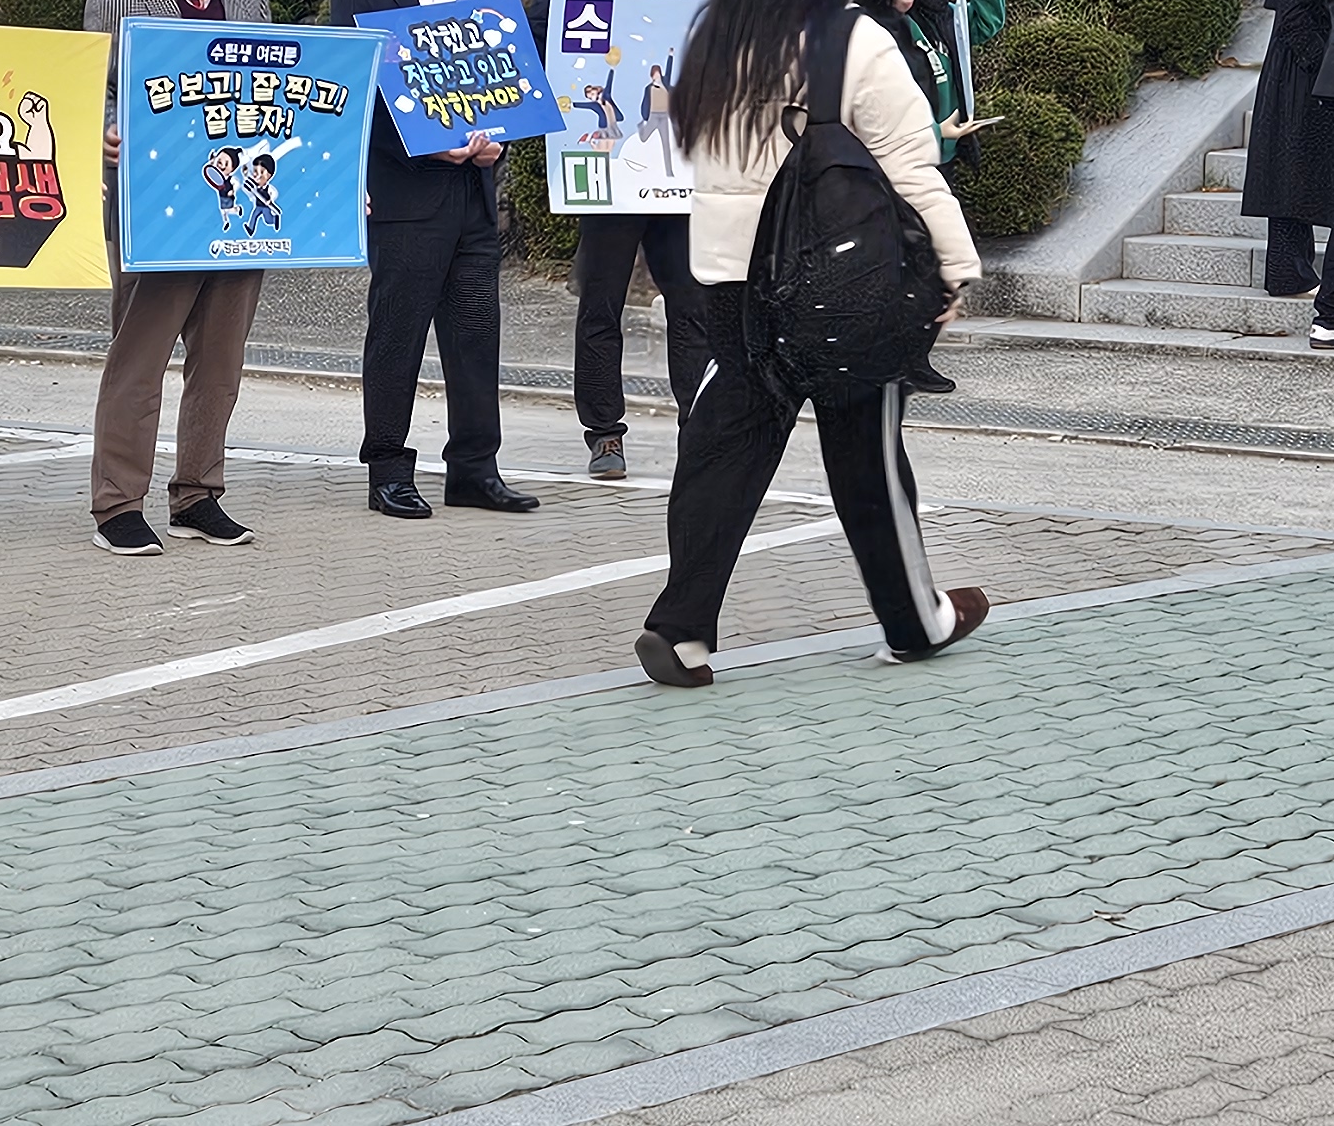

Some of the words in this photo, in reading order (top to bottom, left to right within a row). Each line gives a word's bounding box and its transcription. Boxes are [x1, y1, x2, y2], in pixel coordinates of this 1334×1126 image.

[564, 2, 609, 50] 수
[210, 42, 253, 63] 수험생
[256, 45, 298, 65] 여러분
[477, 52, 517, 85] 있고
[145, 76, 174, 112] 잘
[180, 72, 242, 104] 보고!
[251, 72, 280, 104] 잘
[285, 75, 349, 114] 찍고!
[204, 107, 231, 138] 잘
[236, 104, 294, 138] 풀자!
